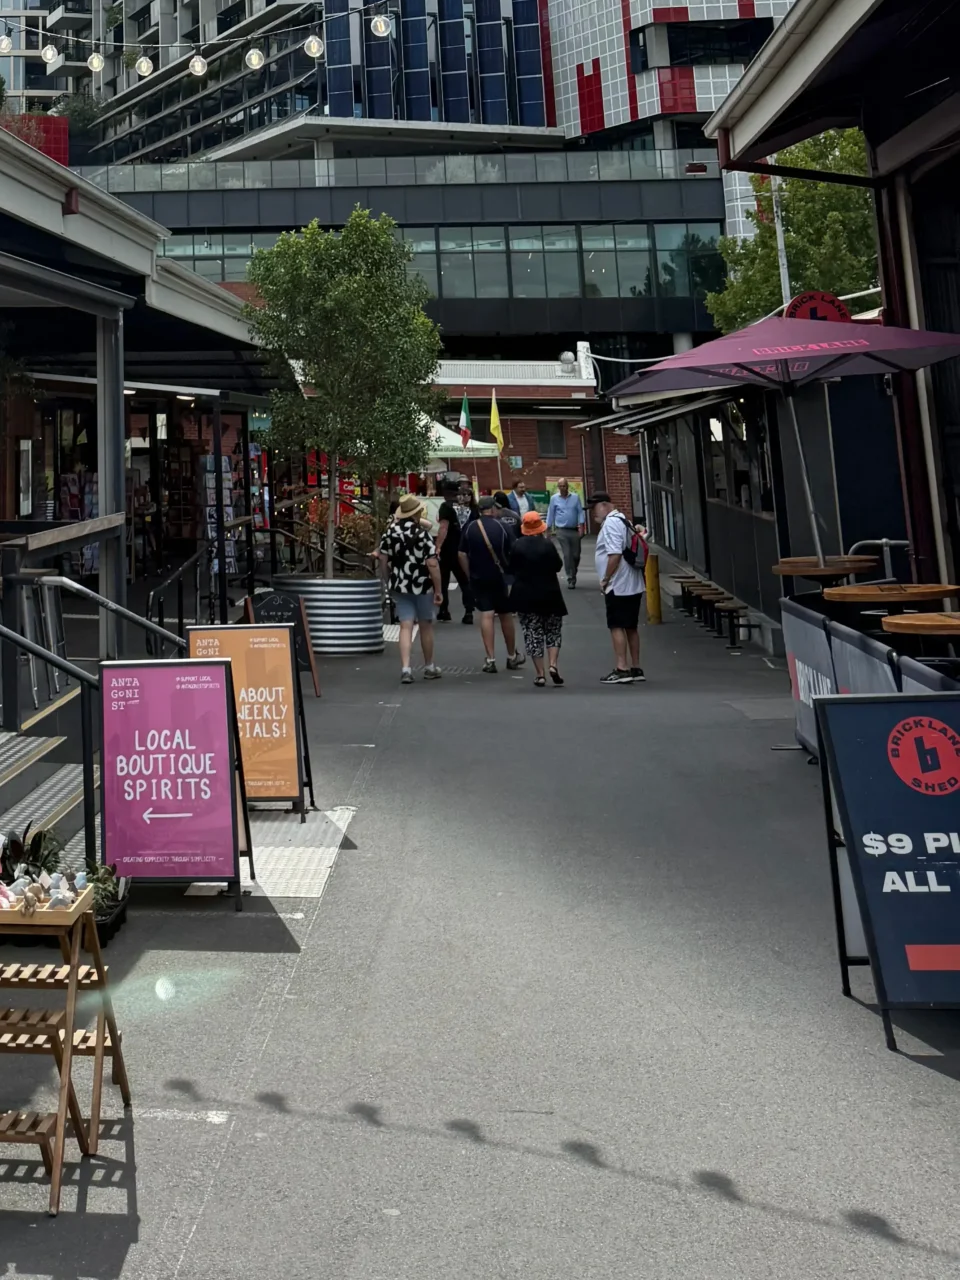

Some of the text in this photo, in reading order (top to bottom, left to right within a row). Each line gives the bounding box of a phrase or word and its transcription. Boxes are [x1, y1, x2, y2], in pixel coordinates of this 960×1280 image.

[111, 677, 140, 687] ANTA
[239, 686, 285, 702] ABOUT
[111, 701, 126, 710] ST
[134, 729, 196, 751] LOCAL
[891, 719, 925, 758] BRICK
[116, 753, 217, 776] BOUTIQUE
[123, 778, 211, 801] SPIRITS
[911, 777, 958, 792] SHED
[862, 831, 913, 857] $9
[882, 871, 951, 892] ALL
